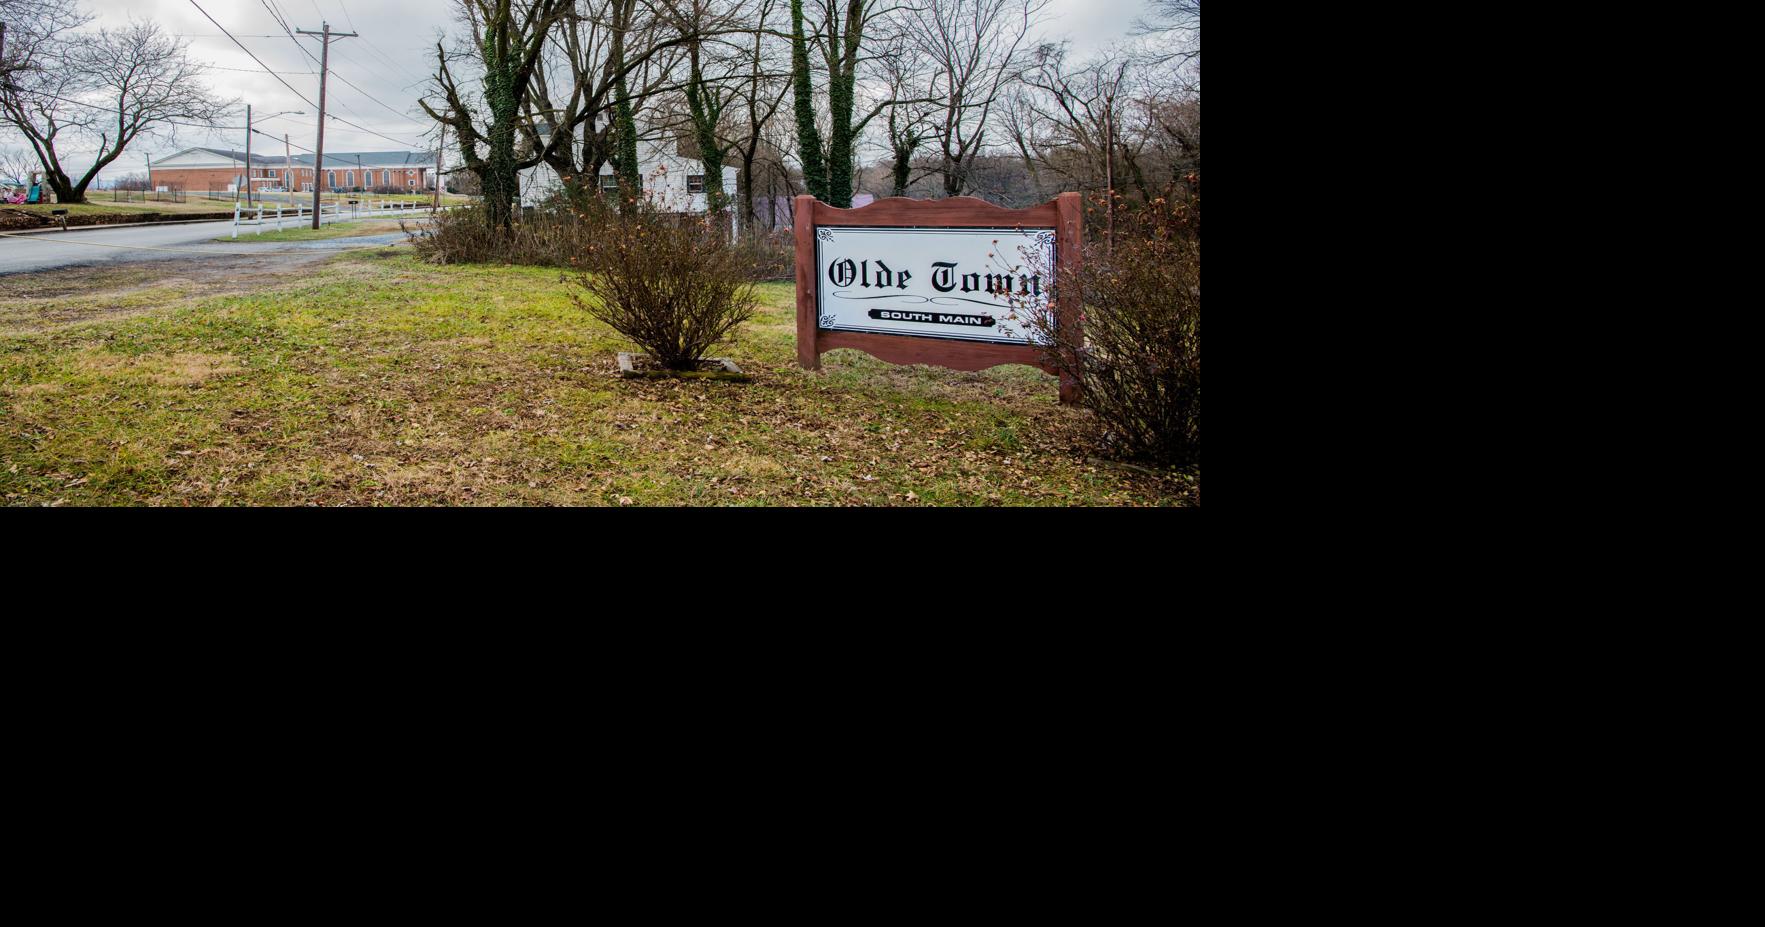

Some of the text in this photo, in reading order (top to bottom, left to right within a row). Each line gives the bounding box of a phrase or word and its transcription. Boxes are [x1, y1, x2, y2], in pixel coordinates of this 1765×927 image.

[828, 257, 1041, 297] Olde Town
[880, 311, 982, 325] SOUTH MAIN
